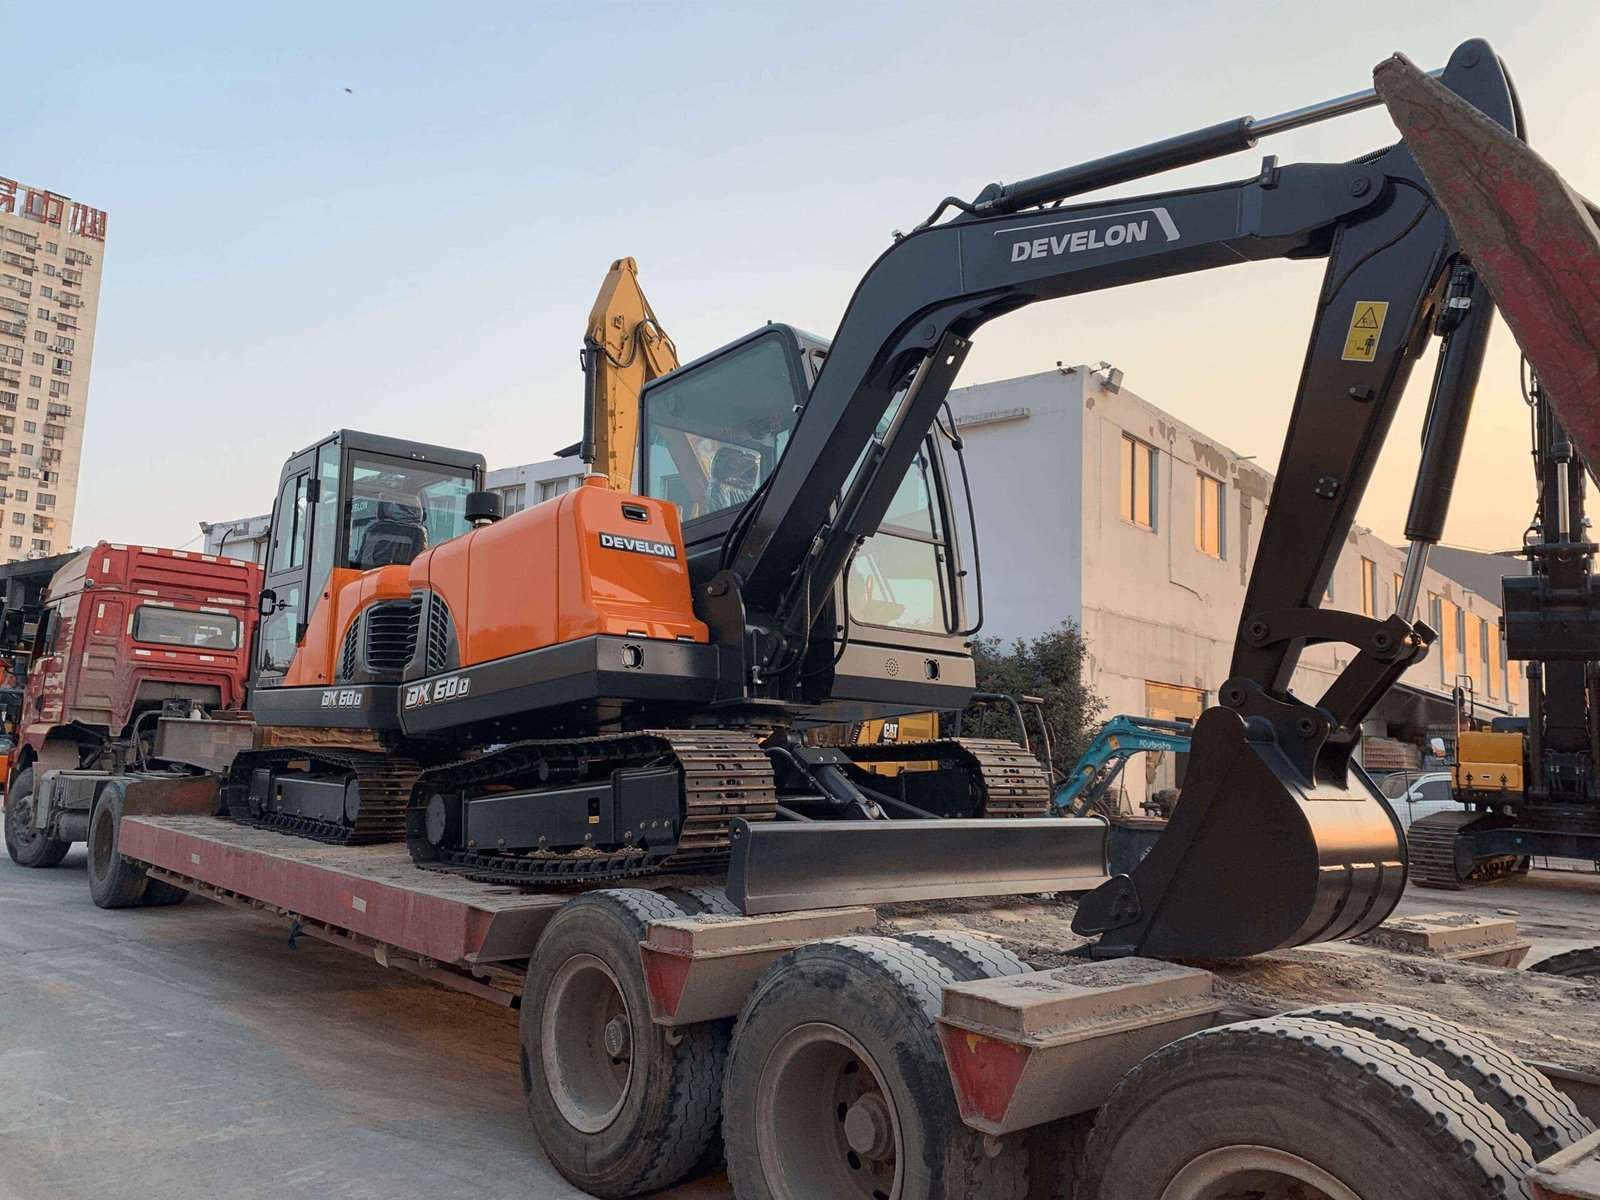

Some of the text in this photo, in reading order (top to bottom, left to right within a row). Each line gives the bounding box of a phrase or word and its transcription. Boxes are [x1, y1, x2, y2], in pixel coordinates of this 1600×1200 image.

[1011, 221, 1149, 262] DEVELON
[601, 534, 675, 557] DEVELON
[406, 683, 431, 708] DX
[884, 723, 898, 739] CAT
[1140, 740, 1171, 750] Kubota
